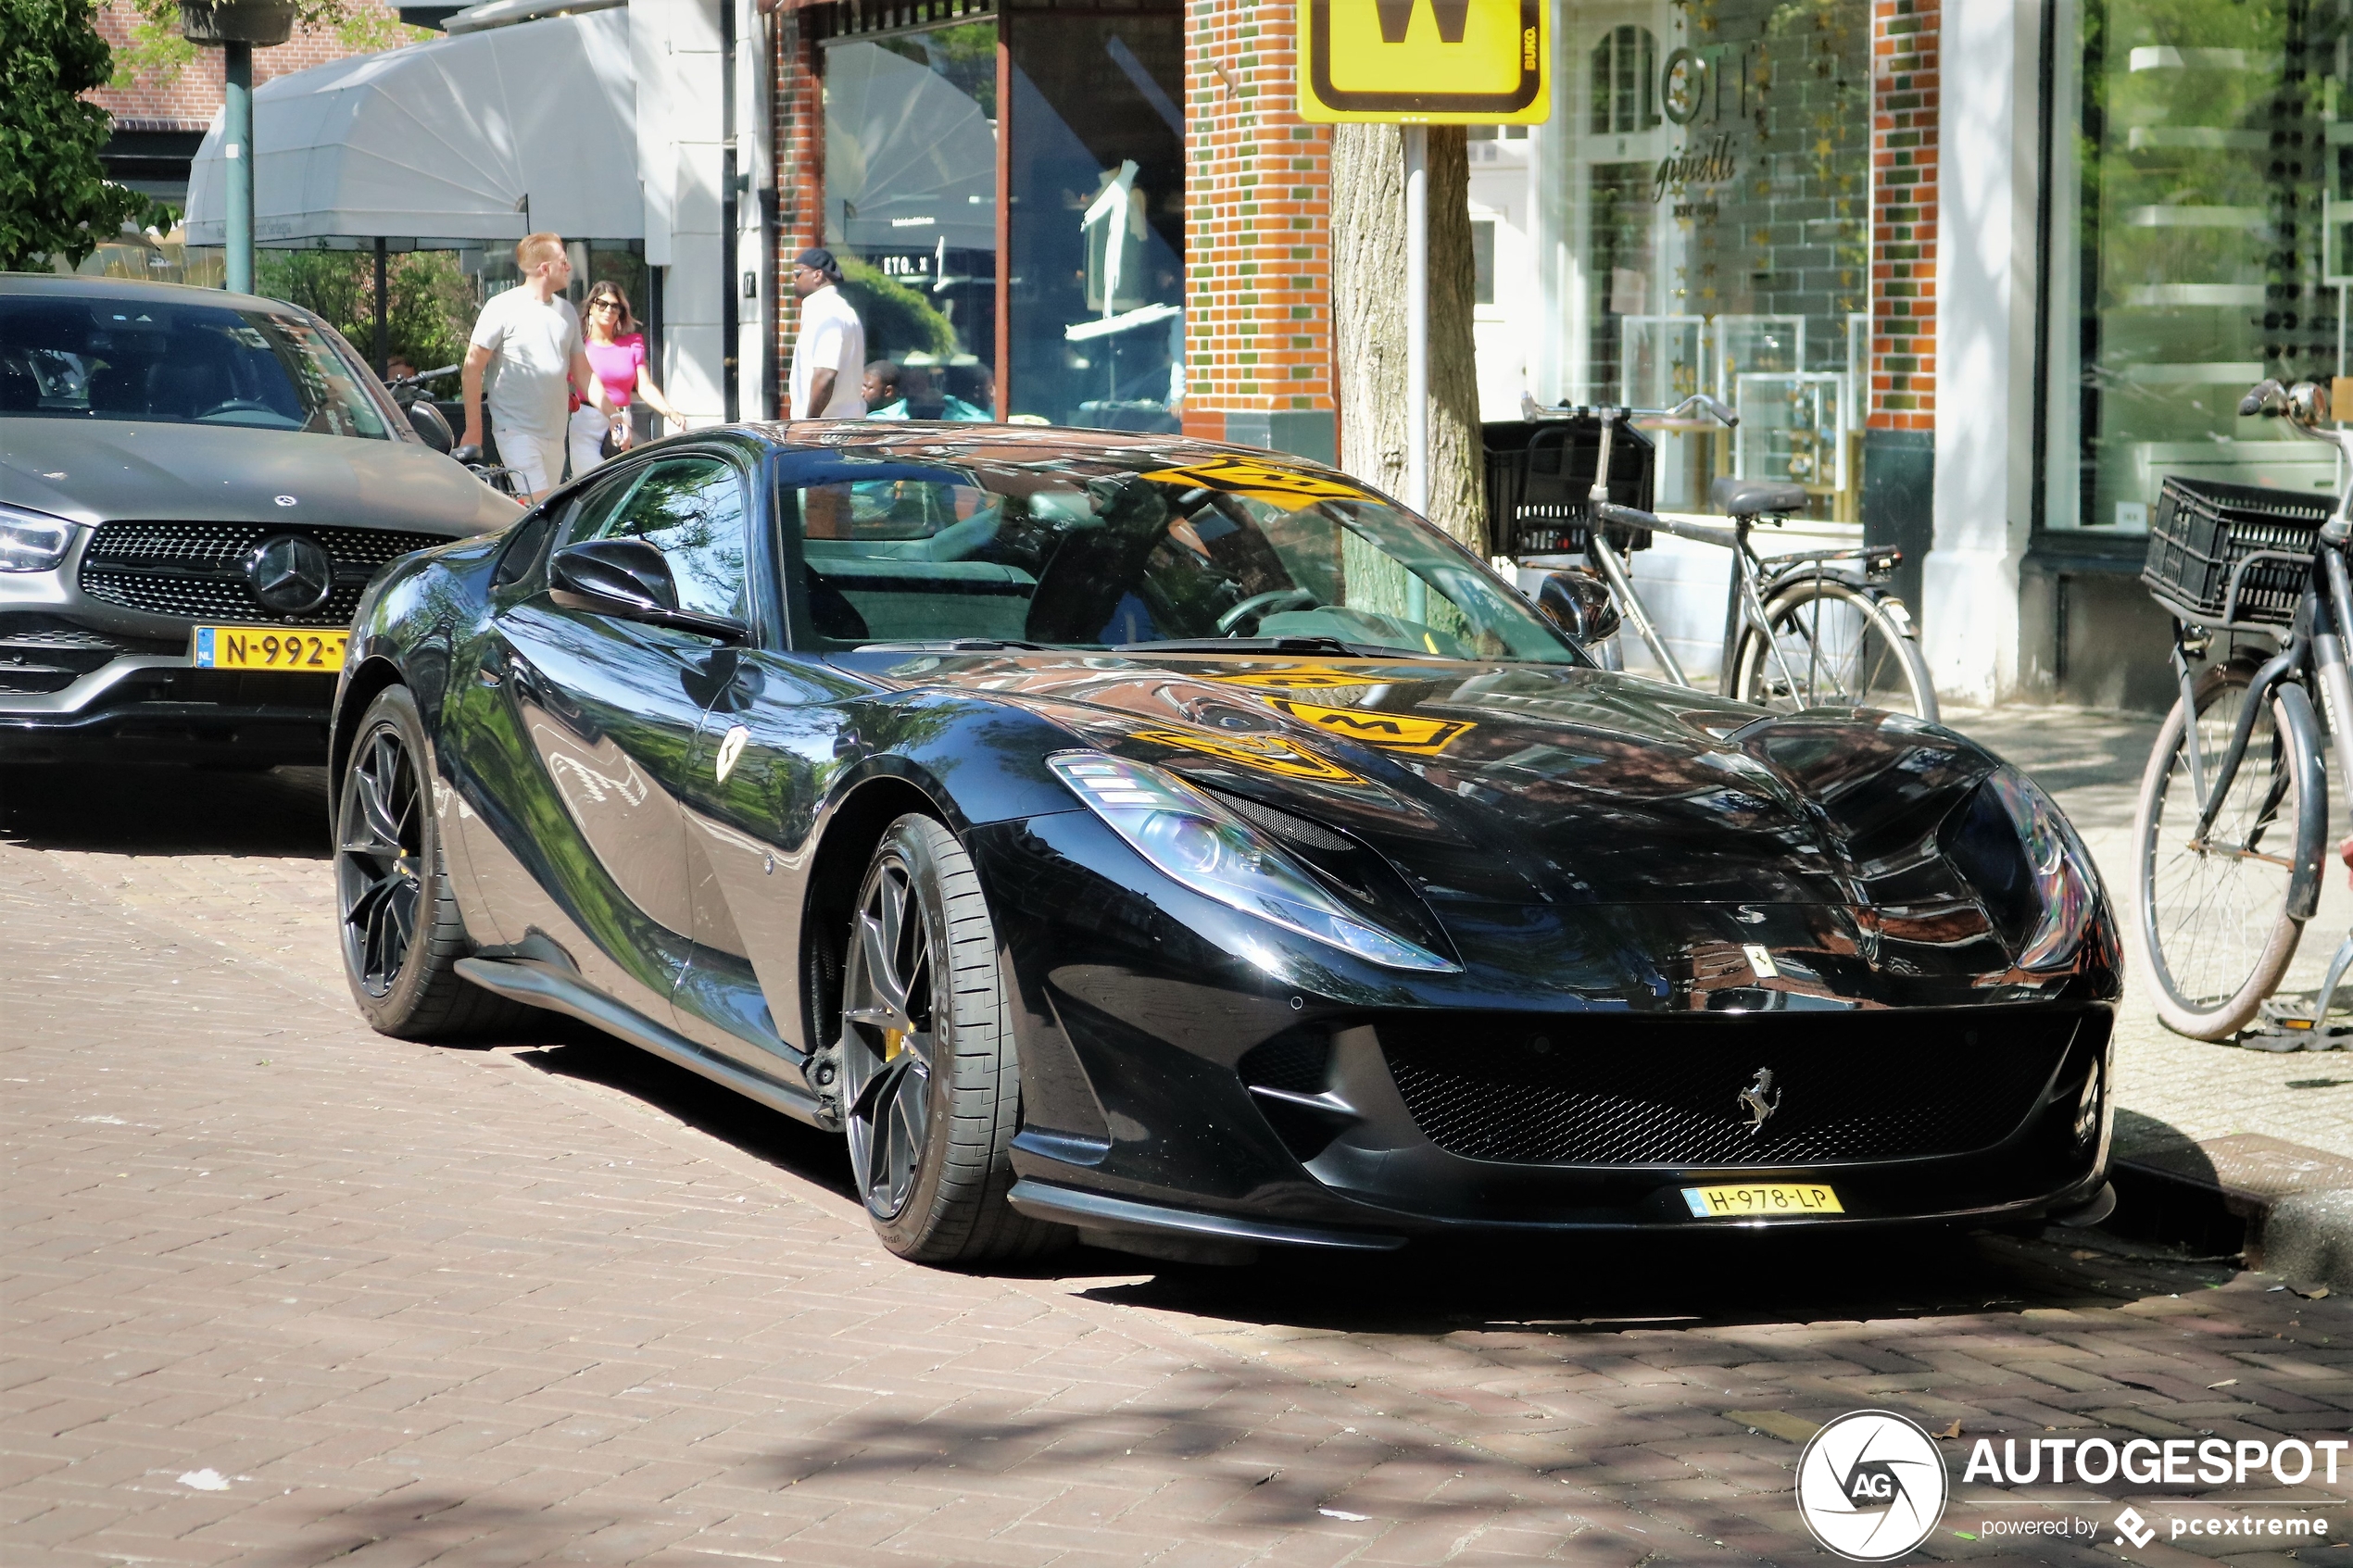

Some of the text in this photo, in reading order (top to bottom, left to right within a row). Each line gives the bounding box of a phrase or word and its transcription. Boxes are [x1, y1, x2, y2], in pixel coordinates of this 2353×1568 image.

[197, 651, 212, 661] NL
[2319, 674, 2339, 735] GIANT
[1708, 1188, 1827, 1211] H-978-LP
